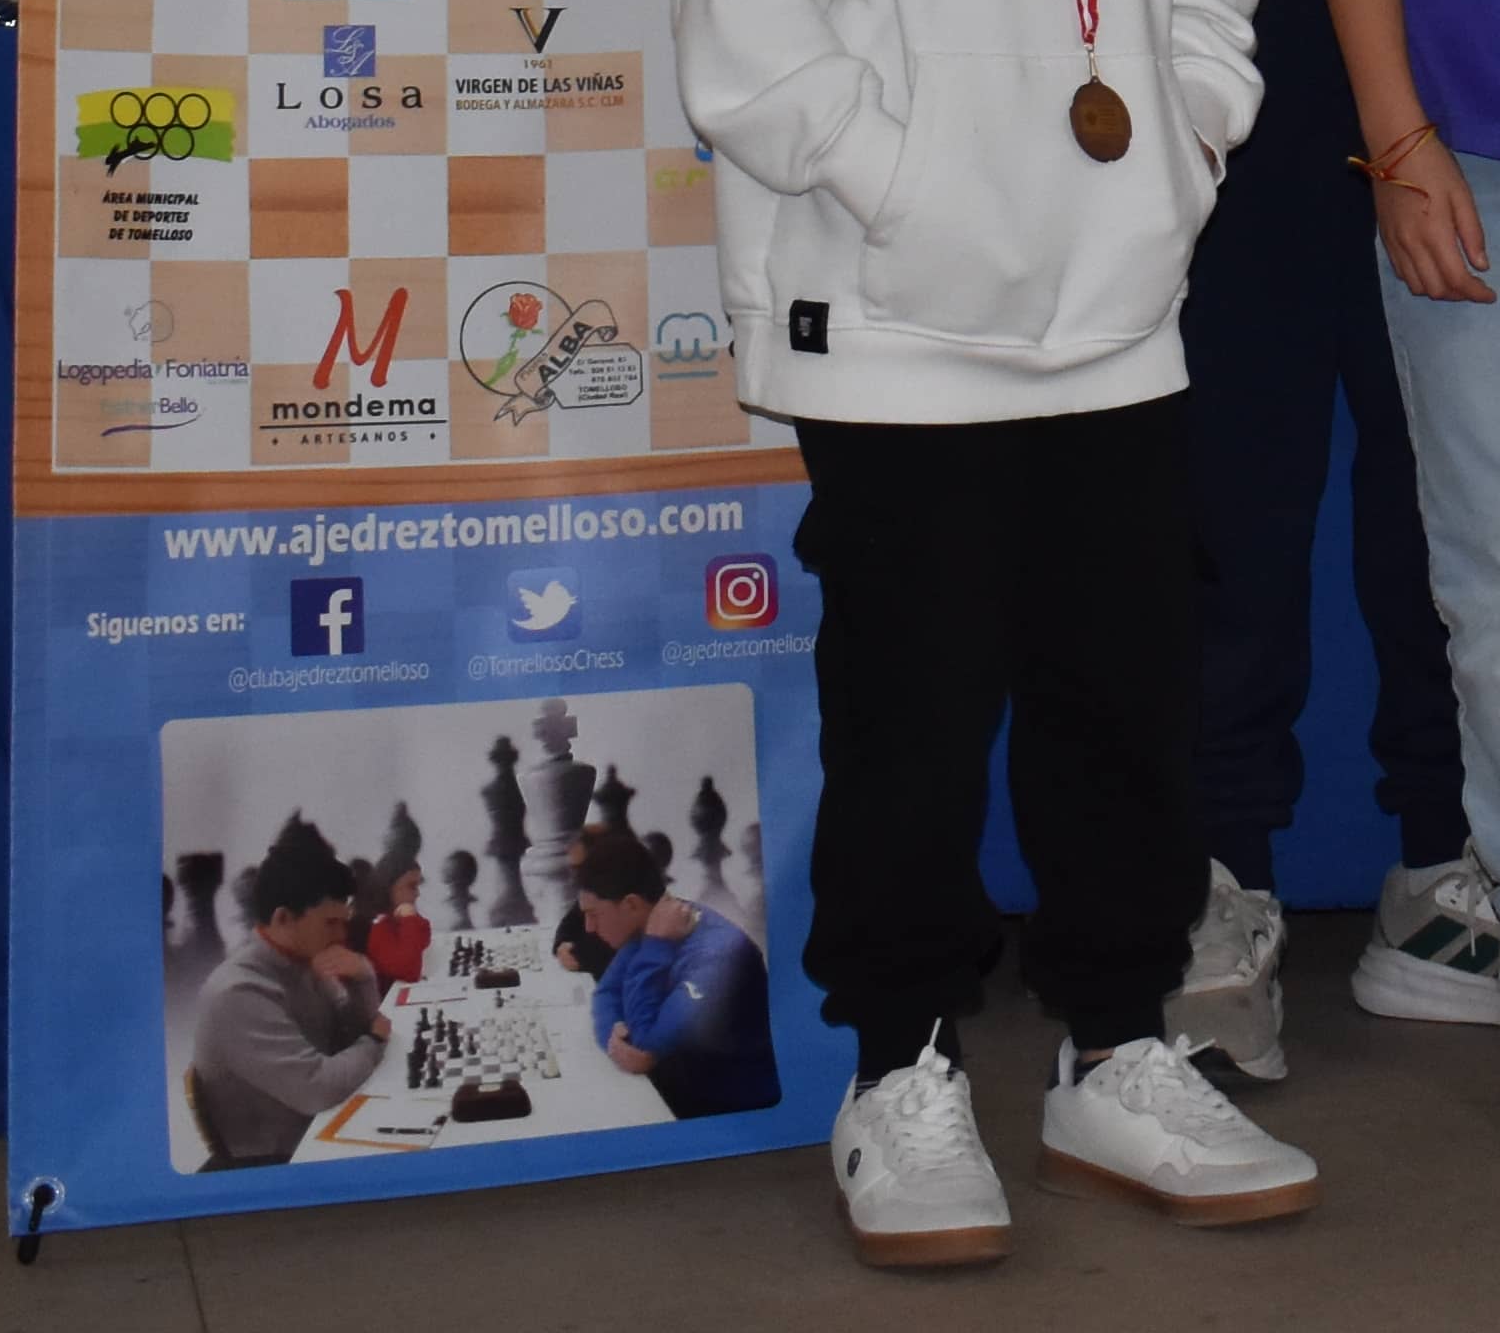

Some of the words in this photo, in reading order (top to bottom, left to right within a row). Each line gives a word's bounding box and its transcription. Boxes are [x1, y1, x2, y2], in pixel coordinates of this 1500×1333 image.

[455, 78, 513, 94] VIRGEN
[518, 78, 539, 94] DE
[543, 77, 572, 93] LAS
[576, 73, 625, 92] VIÑAS
[276, 82, 424, 110] Losa
[455, 98, 501, 111] BODEGA
[503, 99, 512, 110] Y
[513, 97, 575, 110] ALMAZARA
[304, 114, 397, 132] Abogados
[136, 193, 200, 206] MUNICIPAL
[113, 210, 130, 222] DE
[133, 211, 190, 223] DEPORTES
[108, 228, 126, 241] DE
[128, 228, 194, 241] TOMELLOSO
[312, 287, 409, 390] M
[539, 321, 594, 384] ALBA
[58, 358, 153, 386] Logopedia
[272, 394, 437, 420] mondema
[301, 431, 408, 445] ARTESANOS
[164, 501, 743, 566] www.ajedreztomelloso.com
[206, 612, 245, 632] en:
[228, 661, 429, 692] @clubajedreztomelloso
[467, 650, 624, 680] @TomellosoChess
